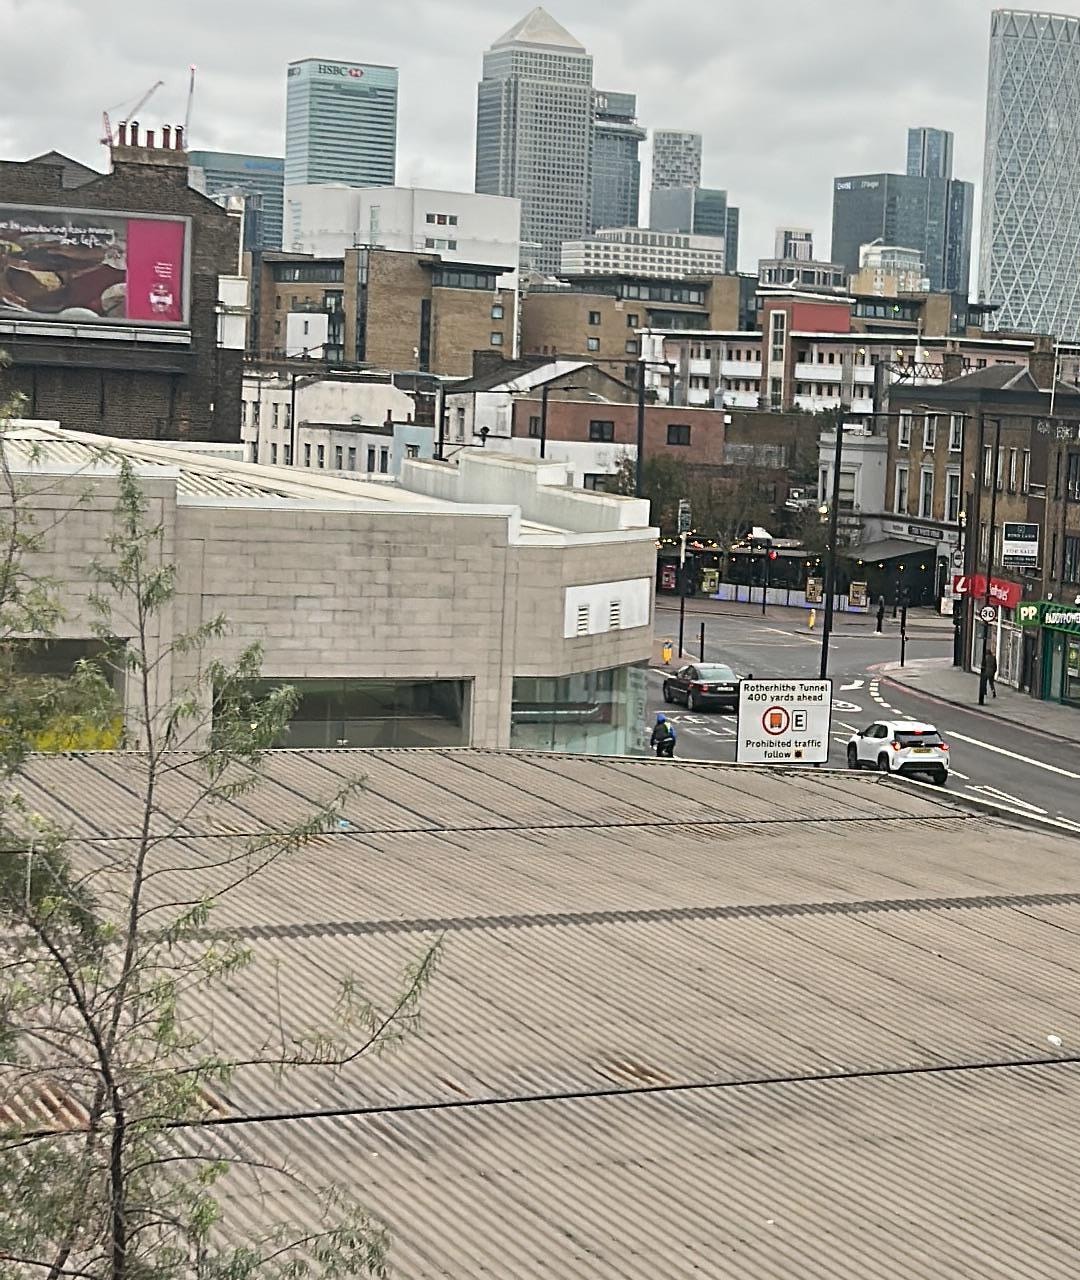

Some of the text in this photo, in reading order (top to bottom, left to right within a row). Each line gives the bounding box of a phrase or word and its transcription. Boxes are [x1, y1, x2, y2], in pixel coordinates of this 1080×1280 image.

[319, 64, 348, 76] HSBC
[982, 610, 994, 618] 30
[1020, 606, 1038, 621] PP
[743, 683, 828, 692] Rotherhithe Tunnel
[747, 693, 768, 701] 400
[770, 693, 794, 702] yards
[795, 715, 804, 728] E
[745, 739, 821, 748] Prohibited traffic
[764, 750, 791, 759] follow
